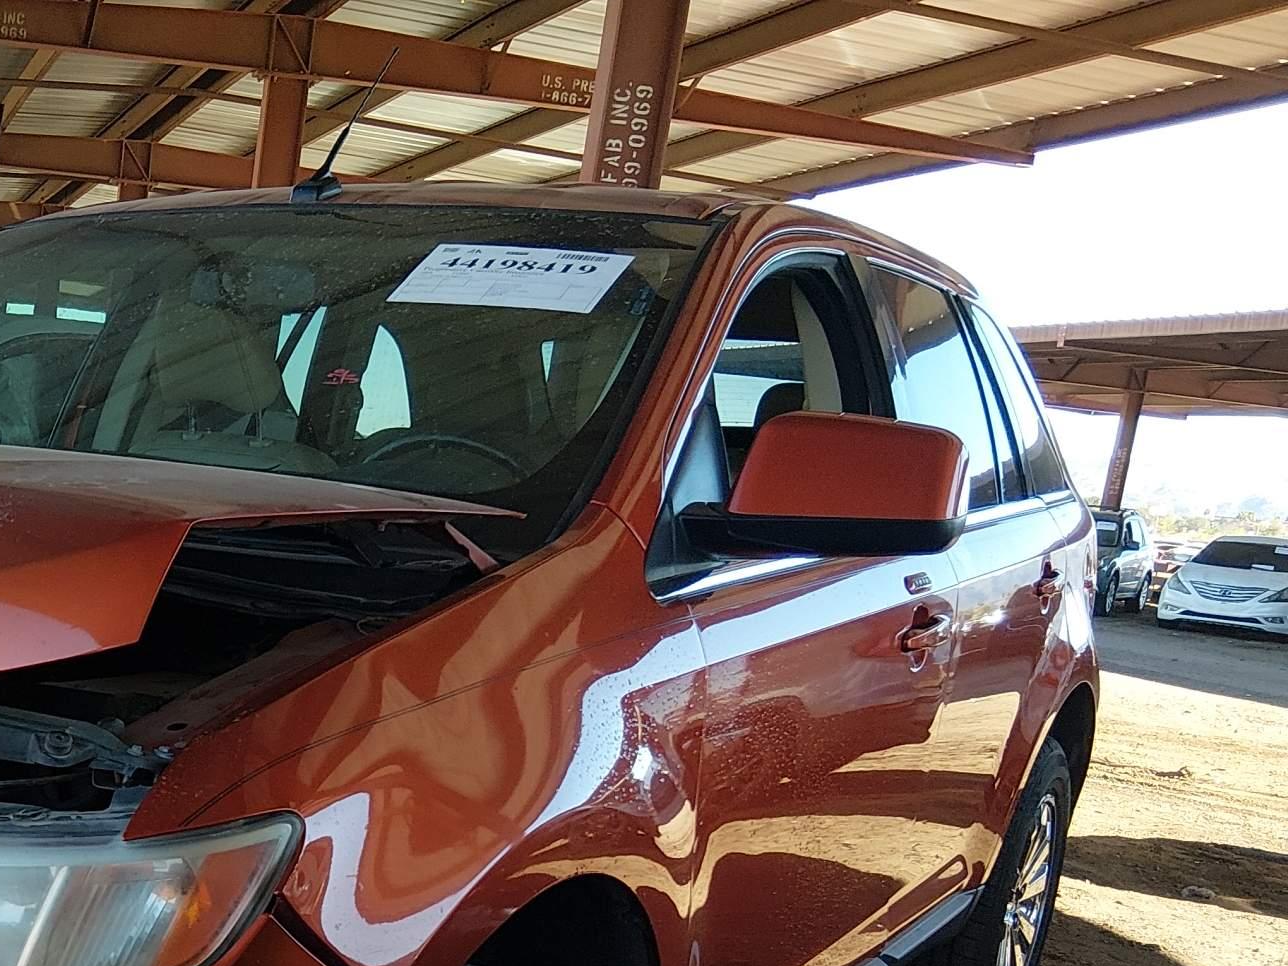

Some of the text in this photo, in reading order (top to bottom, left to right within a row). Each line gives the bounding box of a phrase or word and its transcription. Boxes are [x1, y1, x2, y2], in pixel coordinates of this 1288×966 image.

[542, 74, 566, 90] U.S.
[610, 81, 632, 126] INC.
[440, 256, 598, 275] 44198419
